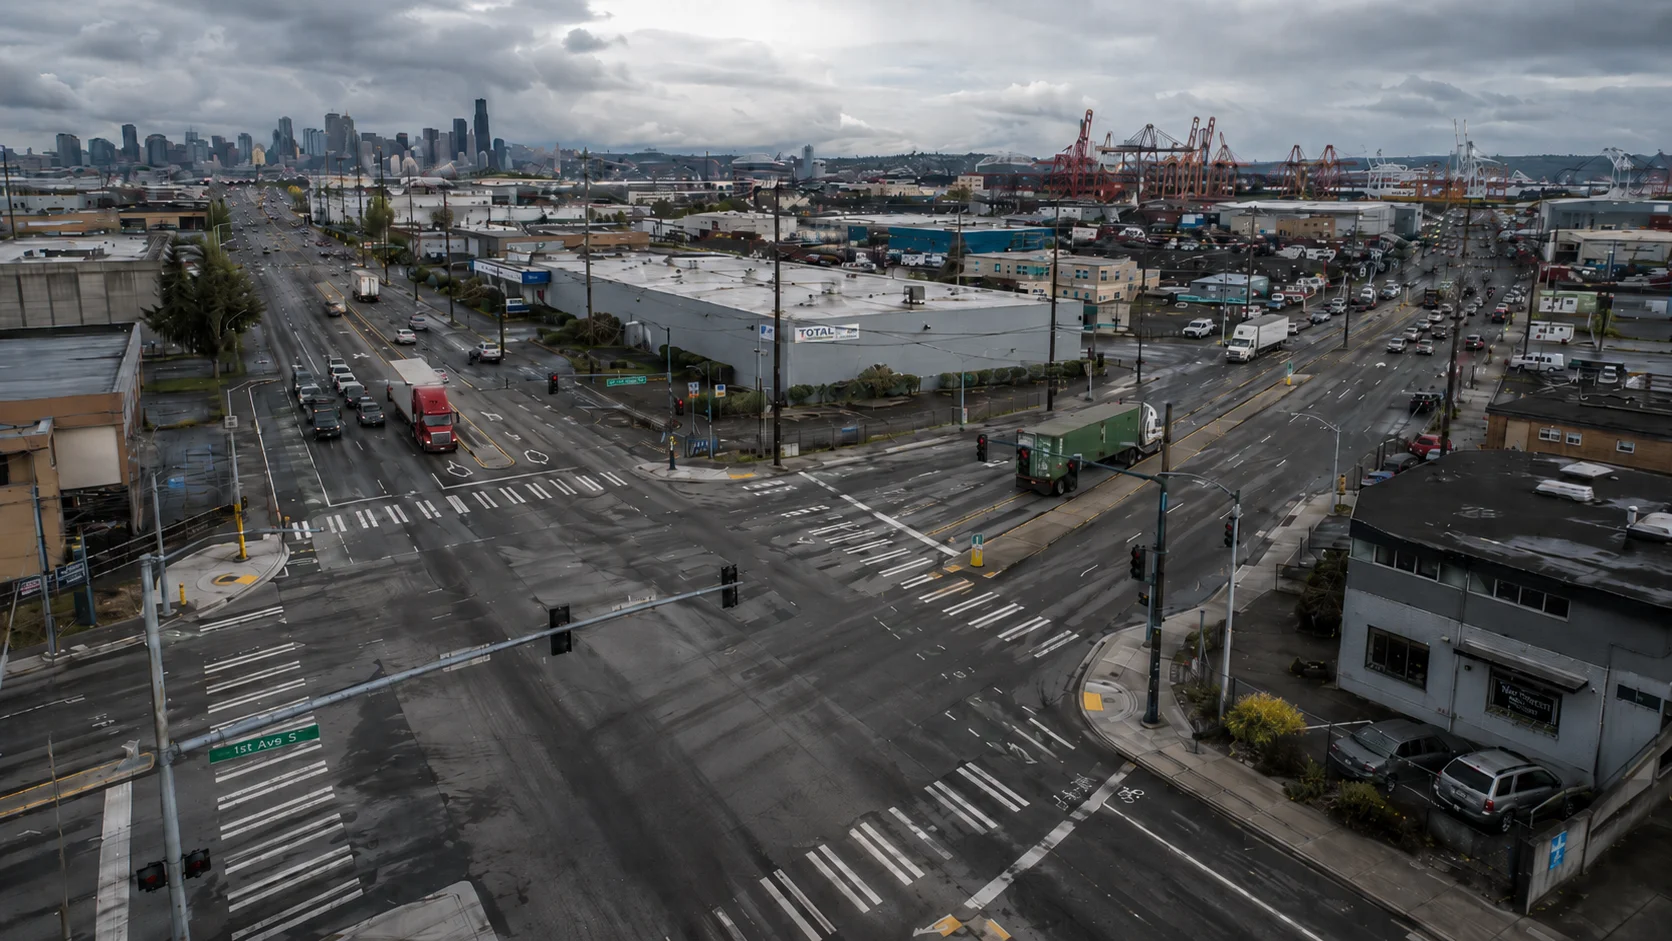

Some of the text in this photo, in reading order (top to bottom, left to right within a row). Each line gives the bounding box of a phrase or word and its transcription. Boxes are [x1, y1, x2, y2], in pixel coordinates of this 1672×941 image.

[799, 327, 834, 338] TOTAL
[234, 732, 297, 754] 1st Ave S
